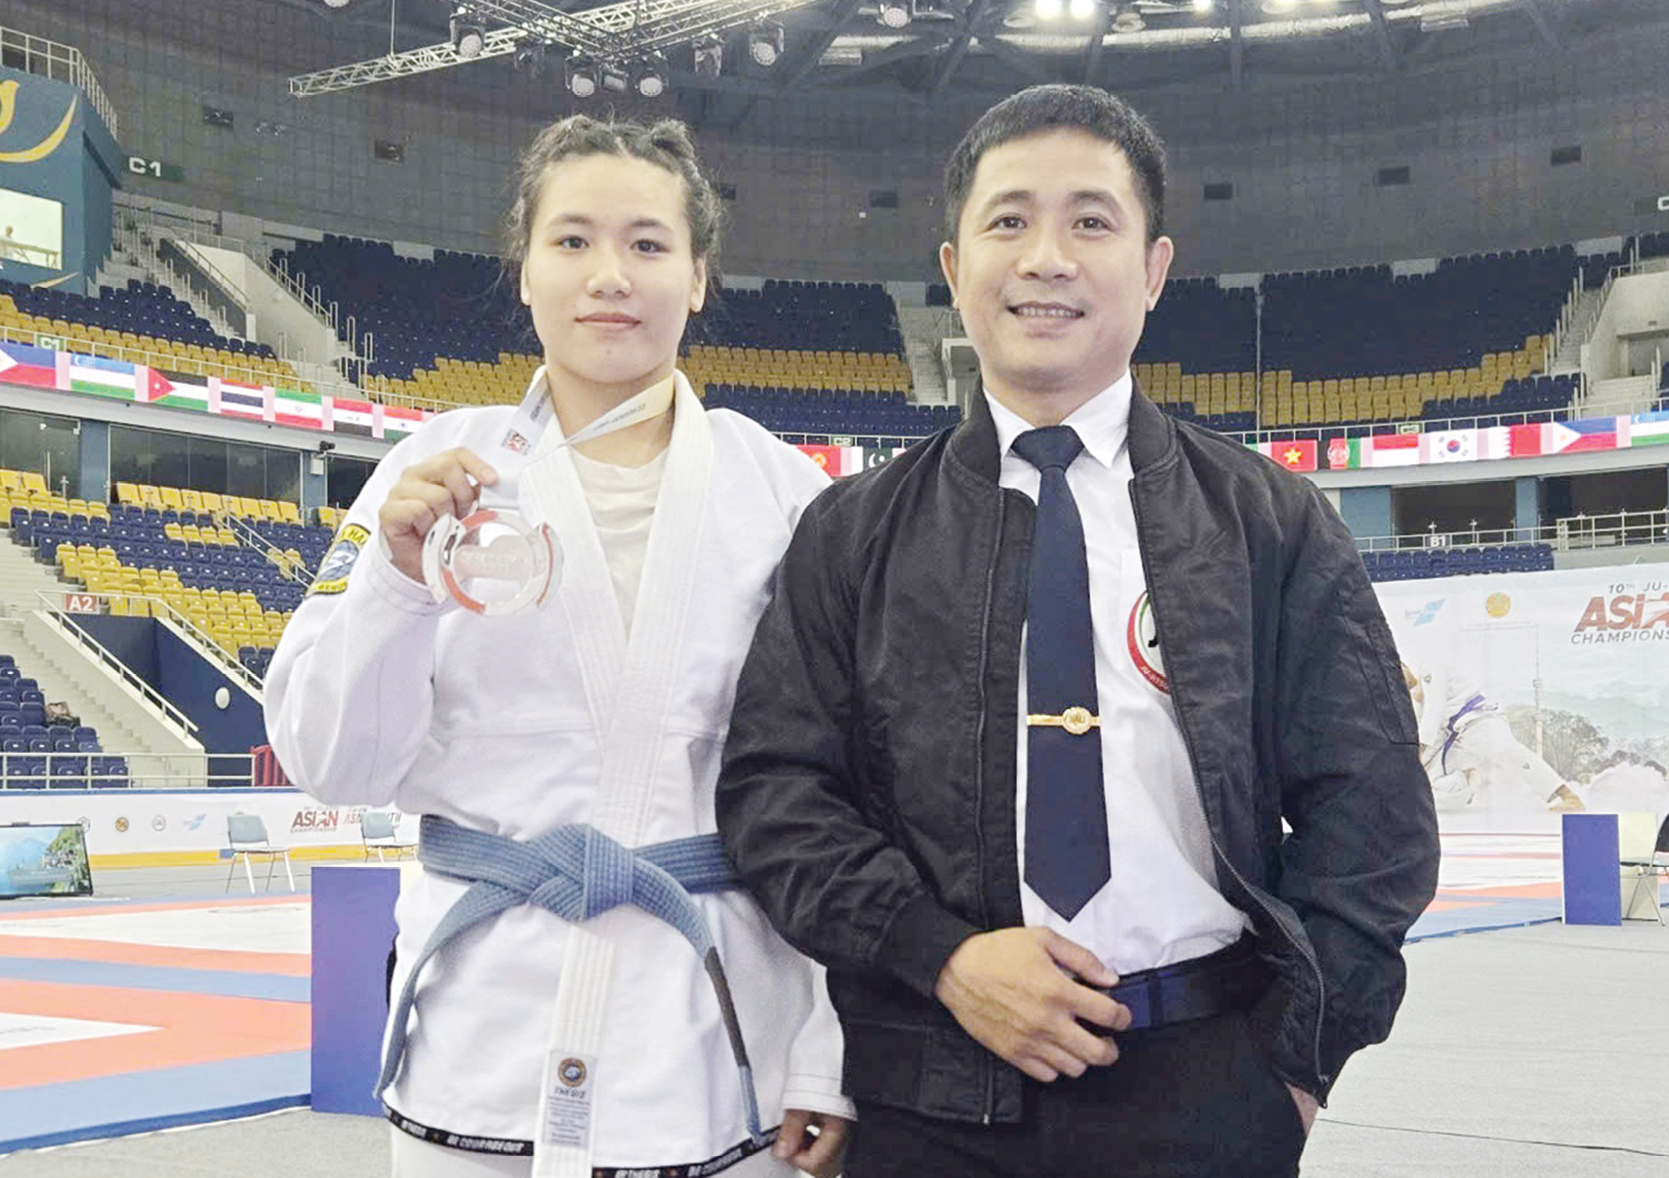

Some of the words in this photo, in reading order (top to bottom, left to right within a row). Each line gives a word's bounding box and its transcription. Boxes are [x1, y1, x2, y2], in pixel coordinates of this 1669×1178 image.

[129, 156, 161, 177] C1
[41, 336, 60, 351] C1
[833, 437, 852, 447] C2
[1430, 536, 1446, 547] B1
[69, 595, 94, 612] A2
[292, 811, 338, 828] ASIAN
